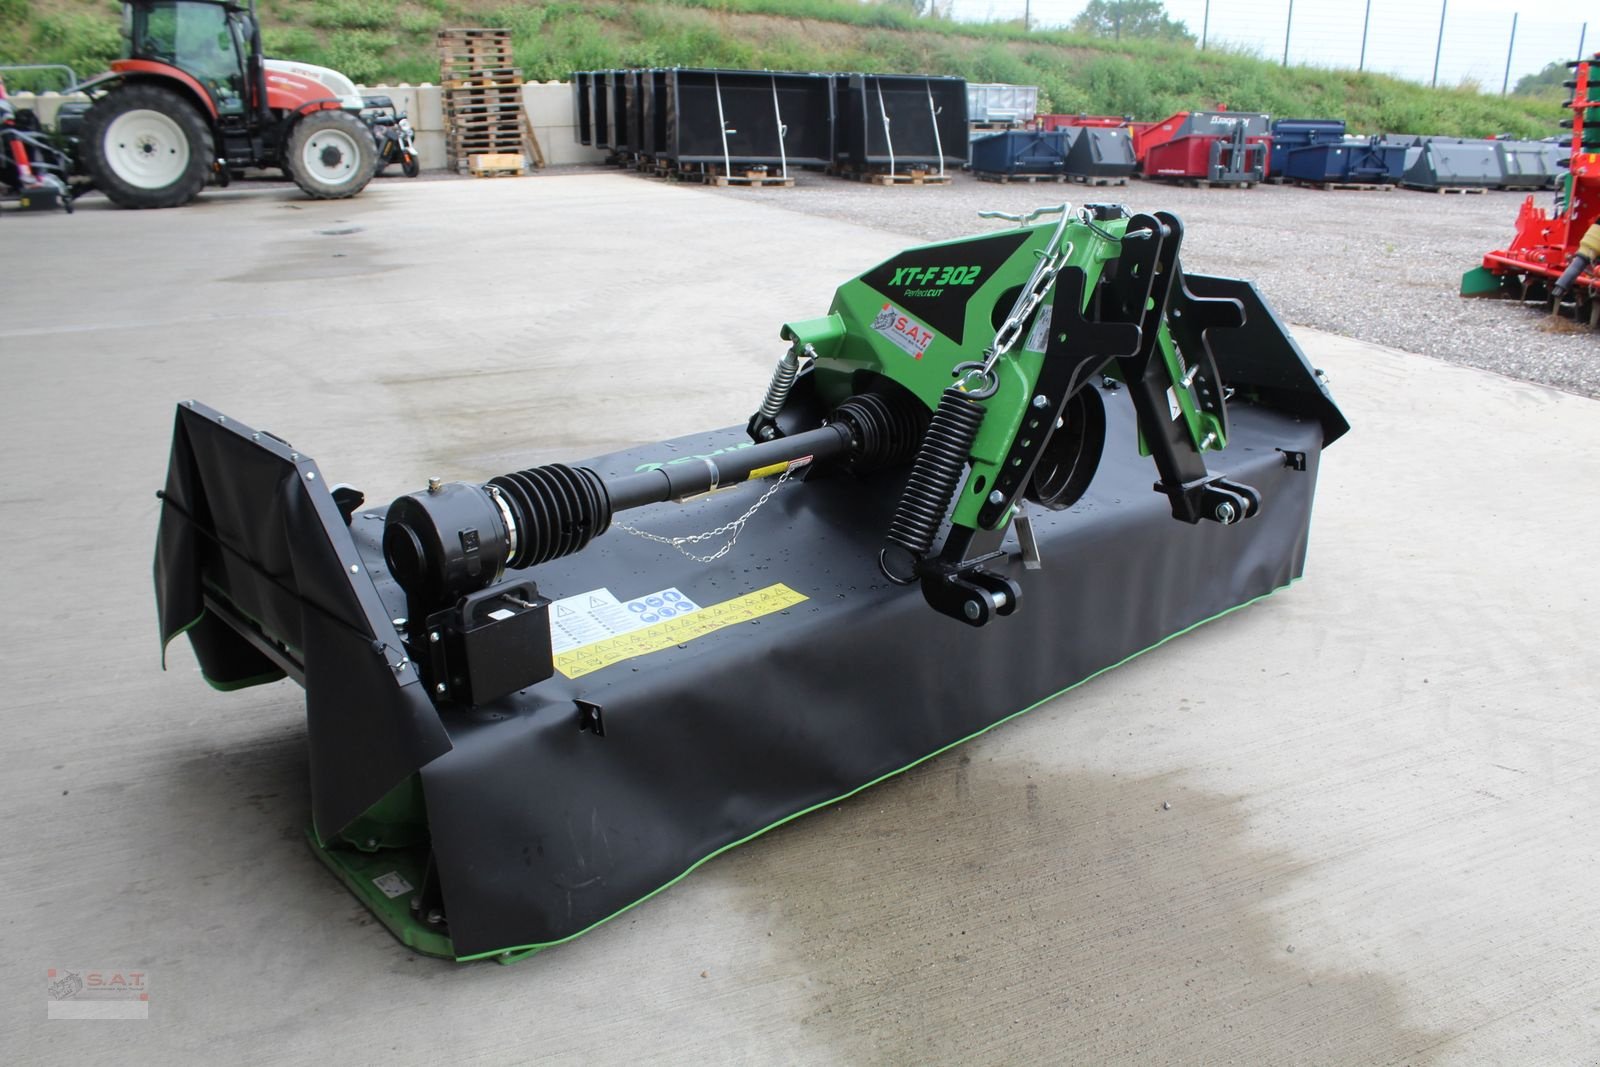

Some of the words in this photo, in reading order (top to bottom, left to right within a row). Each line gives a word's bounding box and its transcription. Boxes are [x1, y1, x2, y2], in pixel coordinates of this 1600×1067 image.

[888, 267, 940, 286] XT-F
[935, 265, 982, 286] 302
[903, 289, 944, 297] PerfectCUT
[894, 317, 932, 348] S.A.T.
